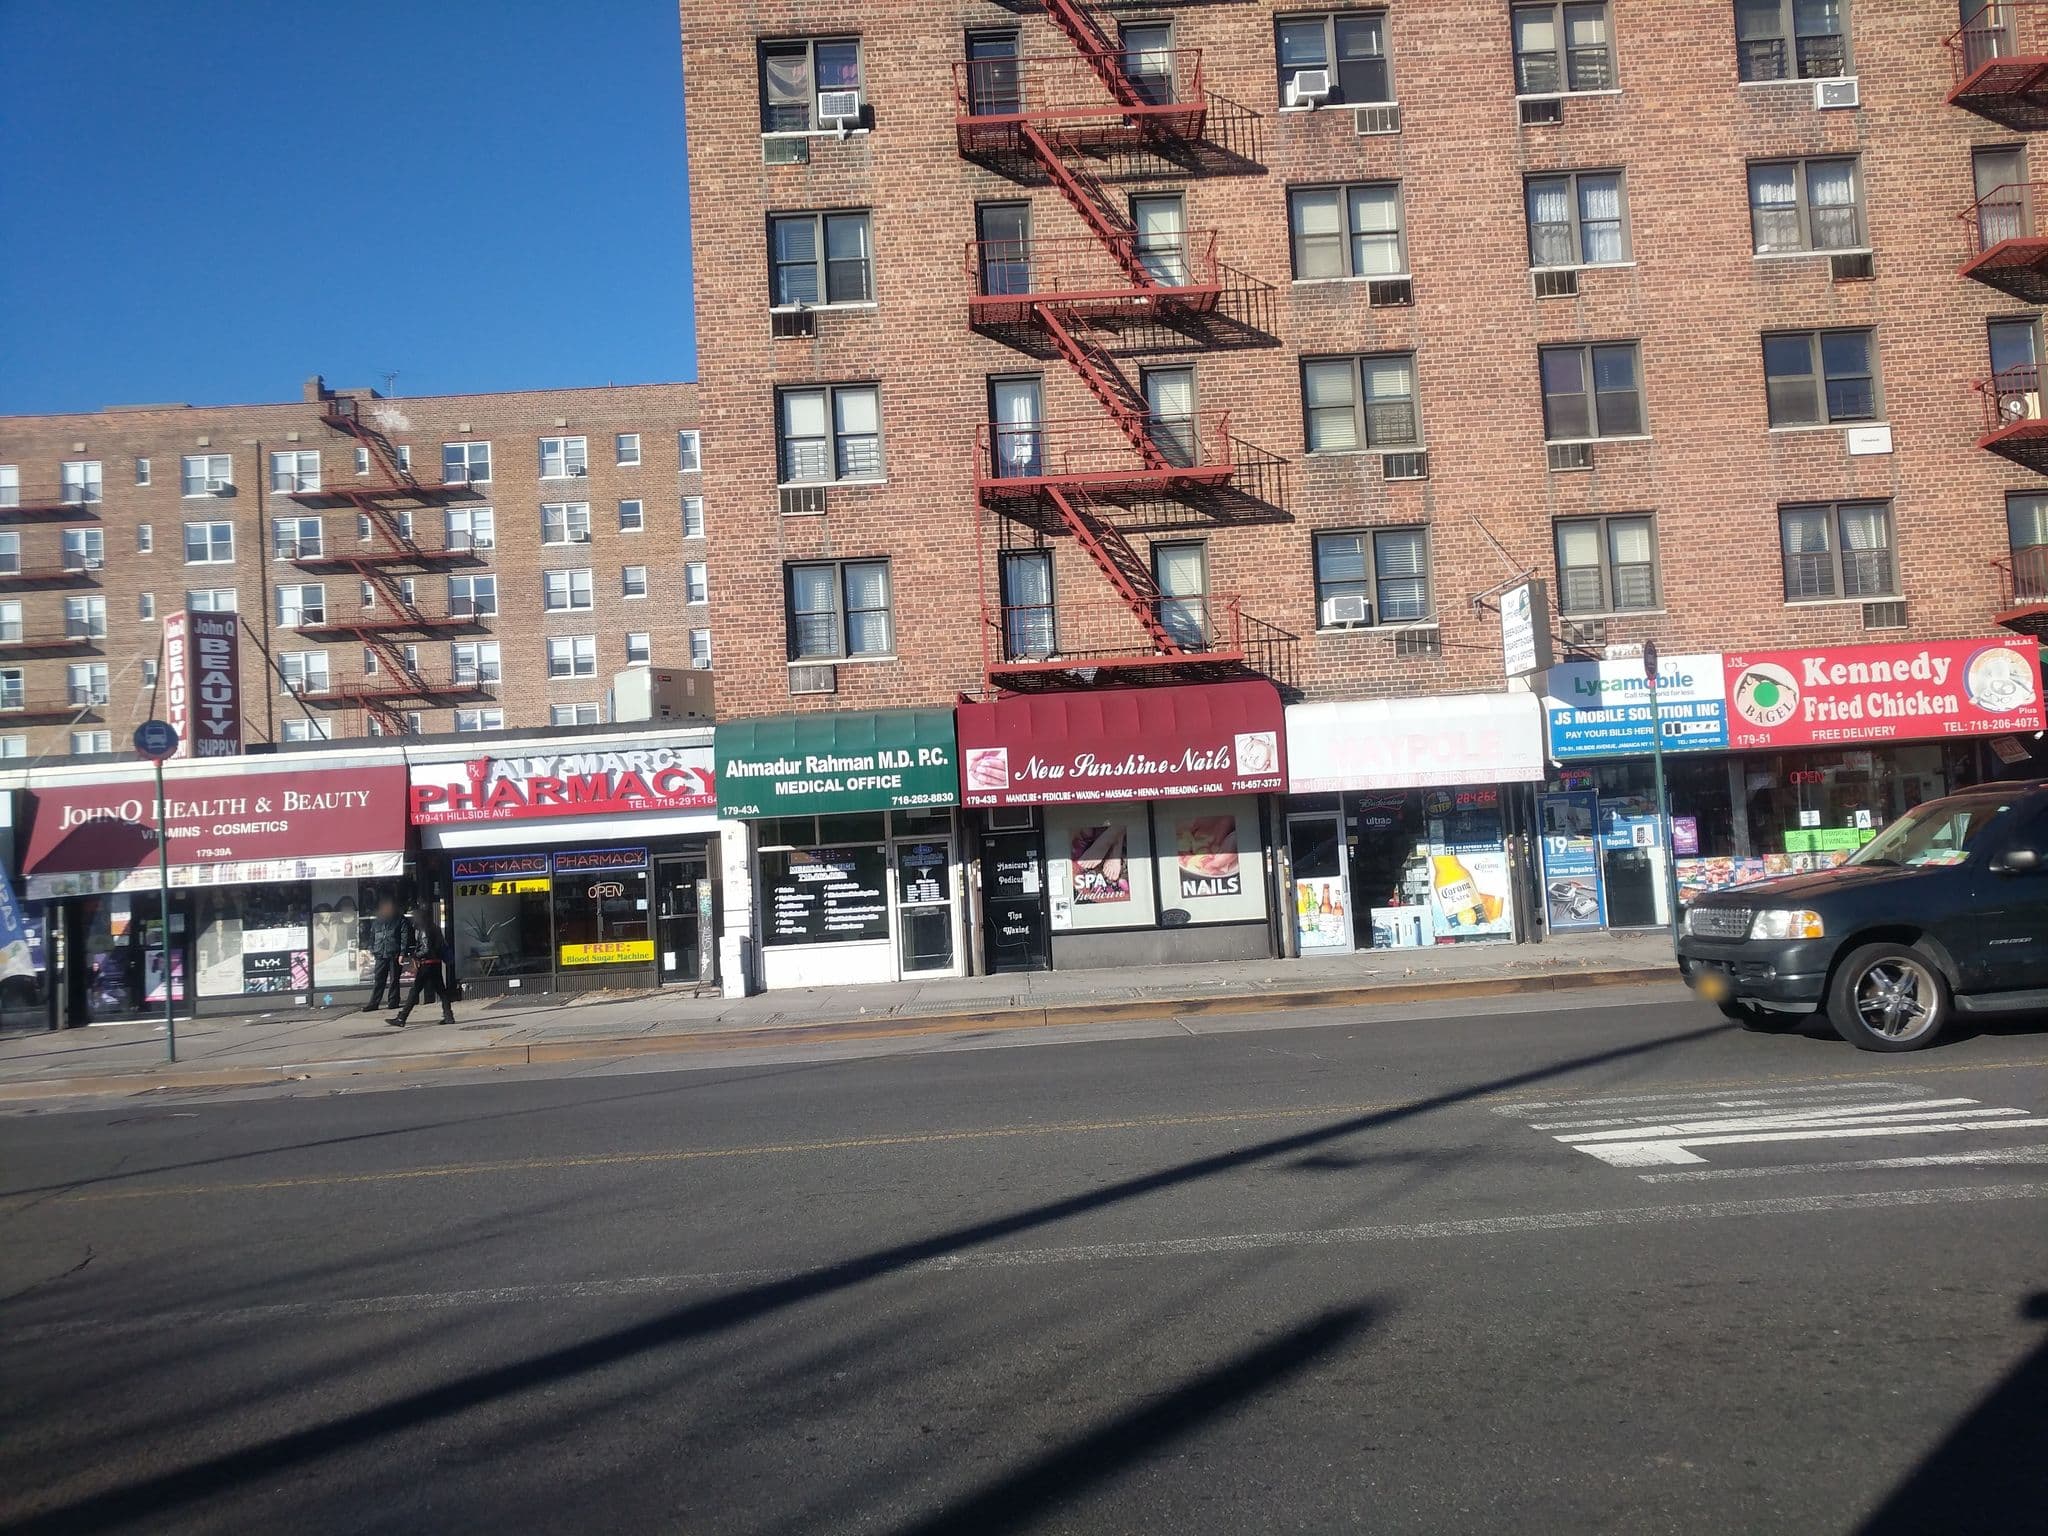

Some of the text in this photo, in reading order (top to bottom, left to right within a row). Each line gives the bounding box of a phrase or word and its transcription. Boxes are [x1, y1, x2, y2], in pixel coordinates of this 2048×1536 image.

[194, 618, 223, 636] John
[225, 620, 236, 638] Q
[1802, 651, 1951, 686] Kennedy
[169, 639, 186, 737] BEAUTY
[200, 638, 234, 735] BEAUTY
[1554, 711, 1571, 726] JS
[1575, 708, 1625, 725] MOBILE
[1696, 703, 1720, 717] INC
[1745, 702, 1794, 723] BAGEL
[1803, 690, 1959, 722] Fried Chicken
[1812, 725, 1896, 741] FREE DELIVERY
[1943, 717, 2040, 733] TEL: 718-206-4075
[1565, 731, 1582, 740] PAY
[1583, 729, 1608, 738] YOUR
[1609, 728, 1633, 737] BILLS
[1737, 733, 1771, 745] 179-51
[197, 739, 238, 756] SUPPLY
[493, 747, 676, 781] ALY-MARC
[725, 747, 949, 778] Ahmadur Rahman M.D. P.C.
[1014, 745, 1231, 781] New Sunshine Nails
[775, 774, 902, 796] MEDICAL OFFICE
[1231, 778, 1282, 791] 718-657-3737
[1789, 770, 1825, 785] OPEN
[410, 767, 716, 814] PHARMACY
[891, 792, 954, 806] 718-262-8830
[1005, 783, 1224, 803] MANICURE PEDICURE WAXING MASSAGE HENNA THREADING FACIAL
[628, 799, 653, 809] TEL:
[966, 794, 998, 805] 179-43B
[151, 796, 246, 821] HEALTH
[254, 796, 273, 814] &
[415, 807, 514, 824] 179-41 HILLSIDE AVE.
[722, 805, 760, 816] 179-43A
[1859, 812, 1868, 824] A
[142, 820, 289, 839] VITMINS COSMETICS
[195, 847, 232, 858] 179-39A
[1548, 835, 1568, 854] 19
[455, 857, 546, 875] ALY-MARC
[556, 851, 645, 868] PHARMACY
[998, 875, 1025, 885] Pedicur
[1074, 873, 1107, 889] SPA
[1182, 877, 1239, 897] NAILS
[459, 881, 517, 897] 179-41
[587, 884, 623, 899] OPEN
[1074, 886, 1126, 905] pedicure
[1441, 881, 1472, 899] Corona
[582, 942, 632, 954] FREE:
[254, 957, 281, 969] NYX
